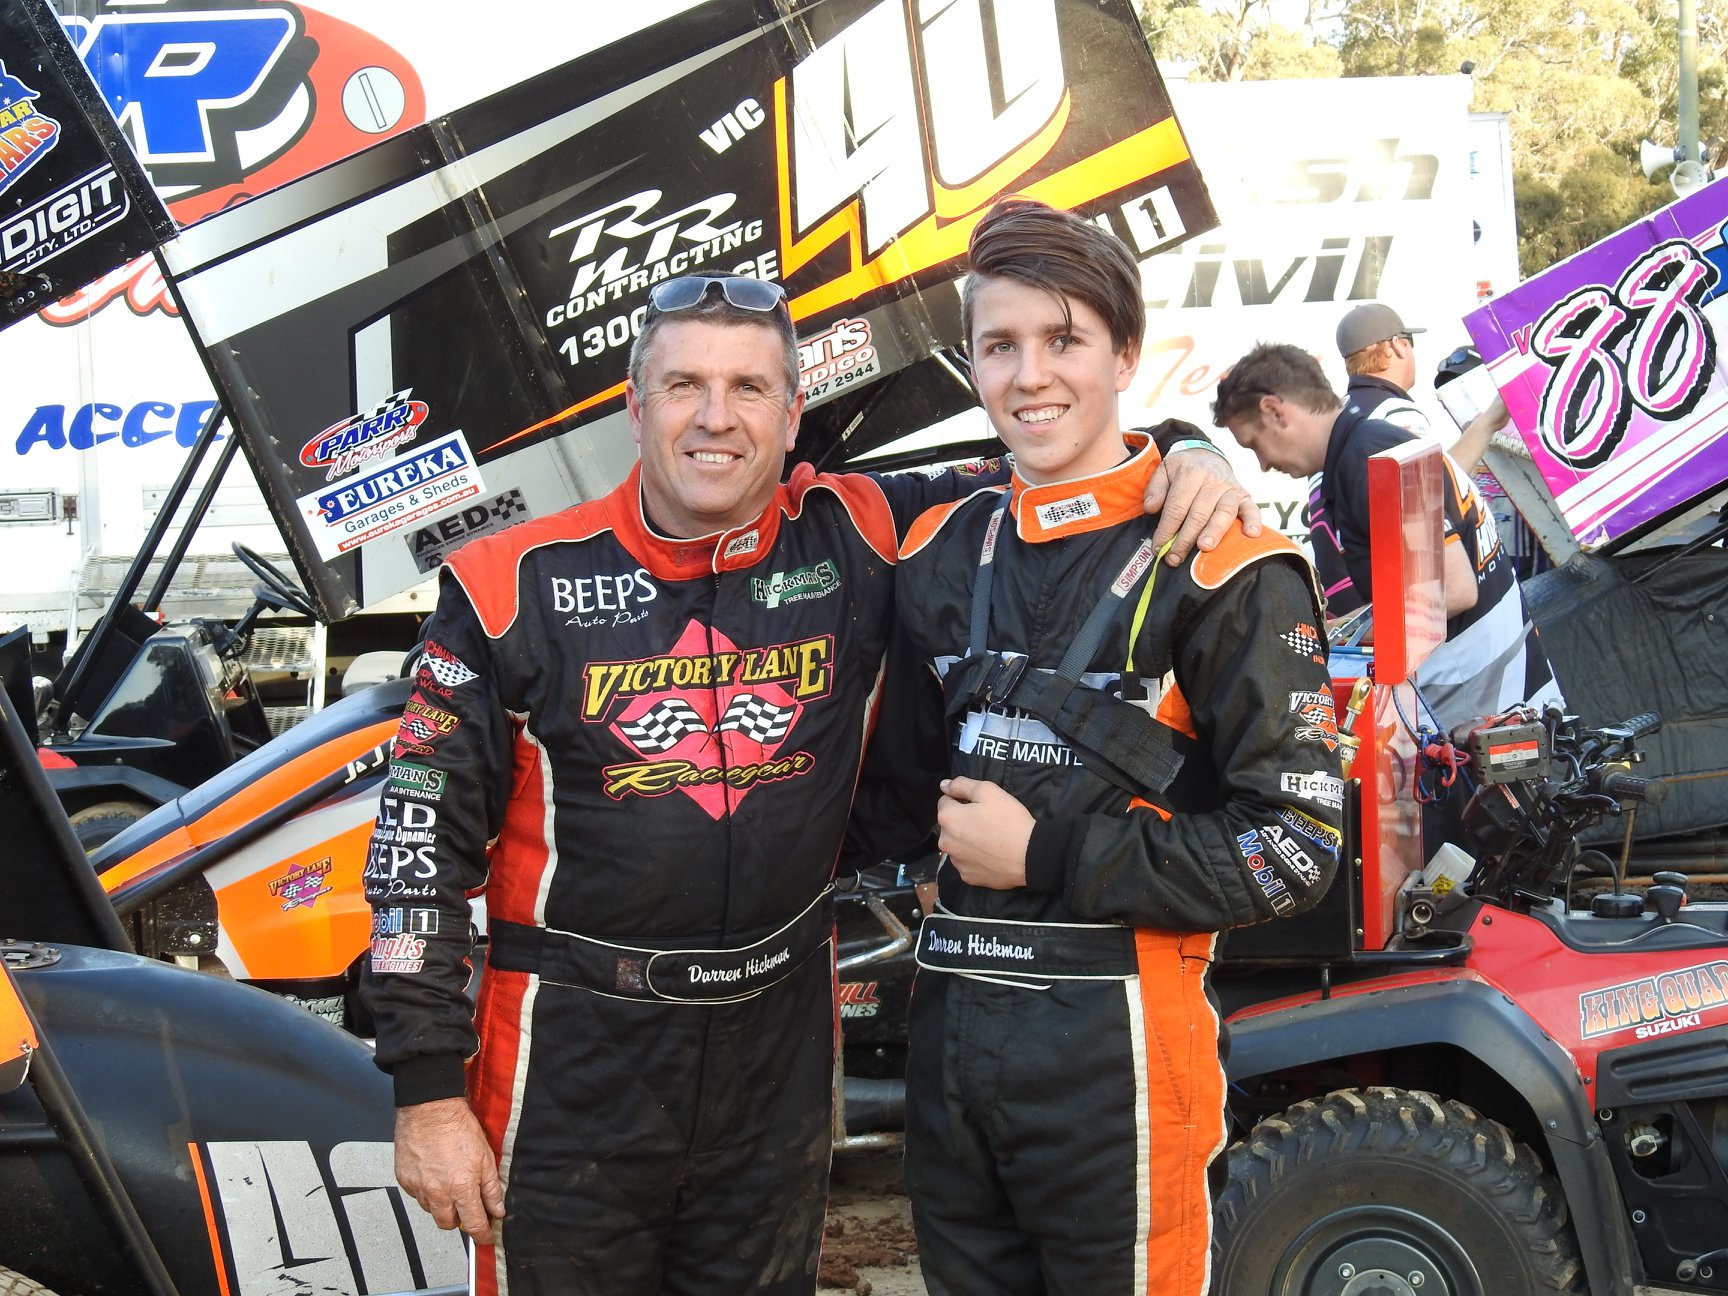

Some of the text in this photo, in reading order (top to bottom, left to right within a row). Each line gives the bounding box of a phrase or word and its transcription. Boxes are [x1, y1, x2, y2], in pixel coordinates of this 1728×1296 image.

[698, 97, 766, 155] VIC
[63, 219, 96, 243] LTD.
[546, 219, 763, 328] CONTRACTING
[834, 362, 874, 388] 2944
[1534, 240, 1720, 468] 88
[318, 403, 412, 462] PARR
[326, 424, 419, 482] Motorsports
[335, 446, 467, 516] EUREKA
[344, 473, 469, 534] Garages & Sheds
[340, 487, 477, 550] www.eurekagarages.com.au
[415, 504, 490, 554] AED
[984, 515, 1000, 554] SIMPSON
[550, 567, 658, 614] BEEPS
[1120, 548, 1151, 589] SIMPSON
[564, 608, 649, 628] Auto Parts
[584, 637, 829, 717] VICTORY LANE
[421, 705, 459, 734] LANE
[605, 753, 810, 796] Racegear
[395, 825, 437, 847] Dynamics
[1262, 824, 1315, 873] AED
[1282, 808, 1338, 849] BEEPS
[1236, 828, 1287, 899] Mobil
[383, 879, 438, 899] Parts
[372, 907, 404, 934] obil
[687, 946, 791, 984] Darren Hickman
[967, 933, 1036, 961] Hickman
[1583, 981, 1661, 1034] KING
[1635, 1013, 1701, 1040] SUZUKI
